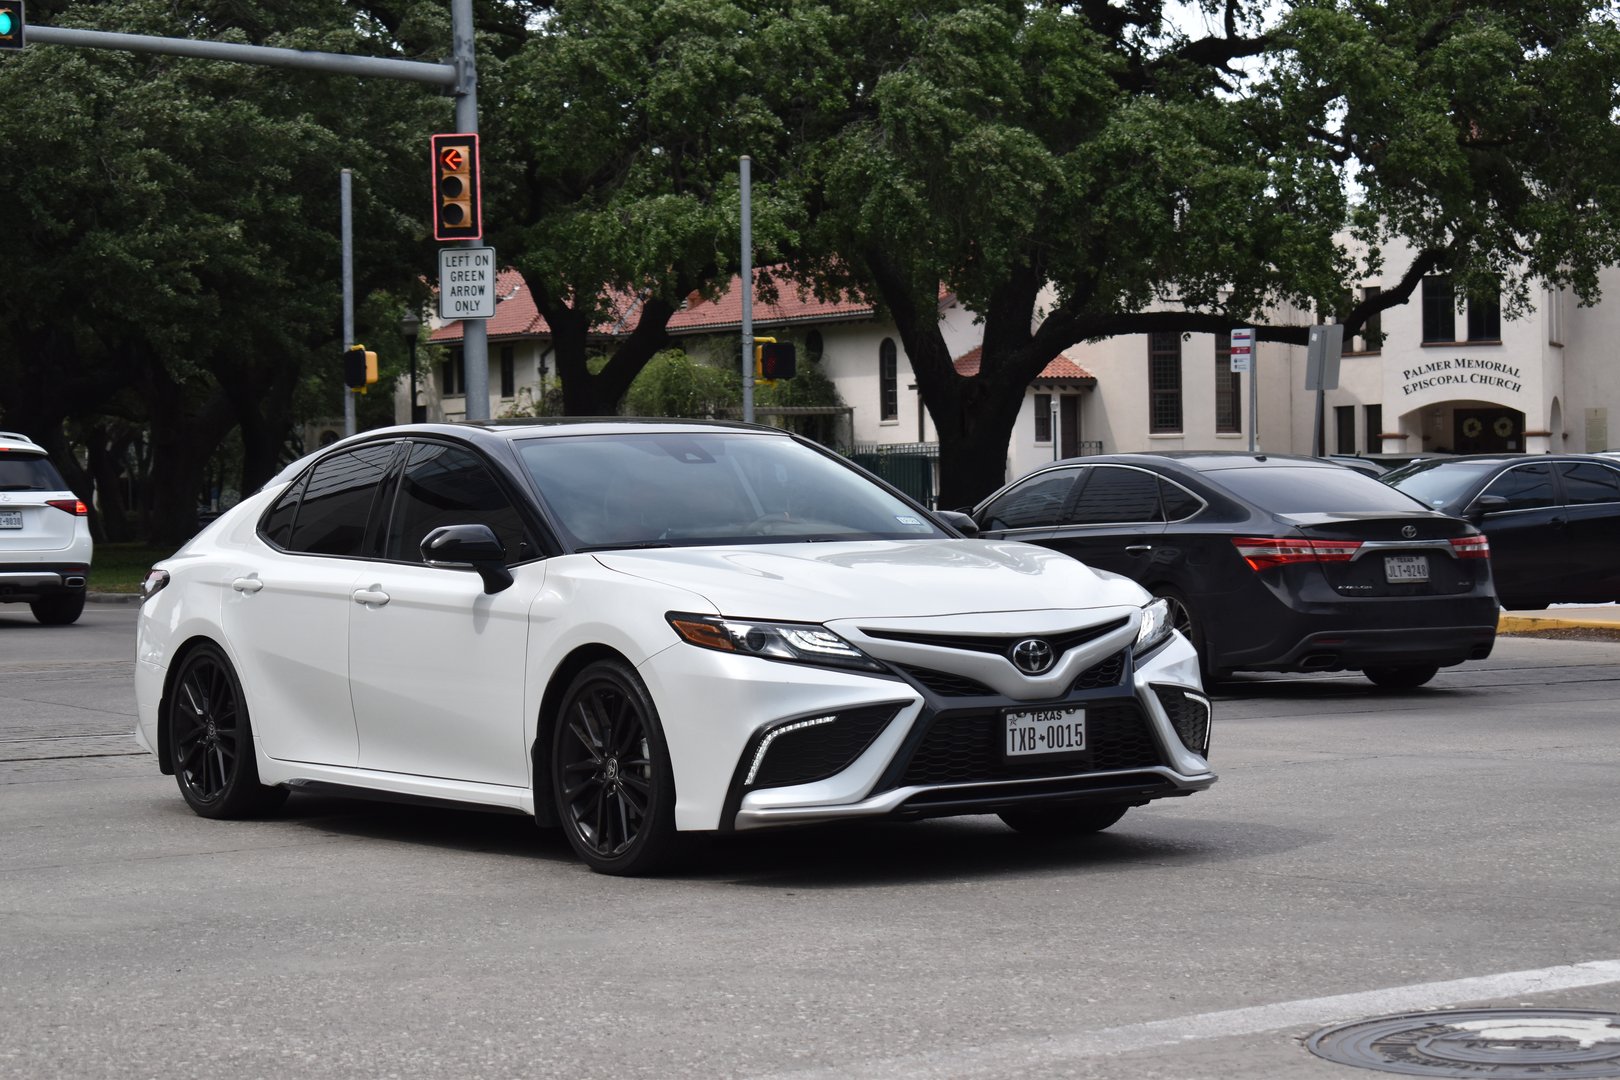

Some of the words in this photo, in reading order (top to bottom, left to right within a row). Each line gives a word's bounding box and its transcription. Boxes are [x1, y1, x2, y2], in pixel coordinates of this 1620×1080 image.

[446, 256, 469, 267] LEFT
[475, 255, 489, 266] ON
[450, 270, 485, 282] GREEN
[450, 285, 485, 297] ARROW
[455, 300, 480, 312] ONLY
[1402, 360, 1452, 380] PALMER
[1454, 358, 1521, 378] MEMORIAL
[1402, 374, 1468, 396] EPISCOPAL
[1470, 373, 1522, 393] CHURCH
[1030, 711, 1063, 722] TEXAS
